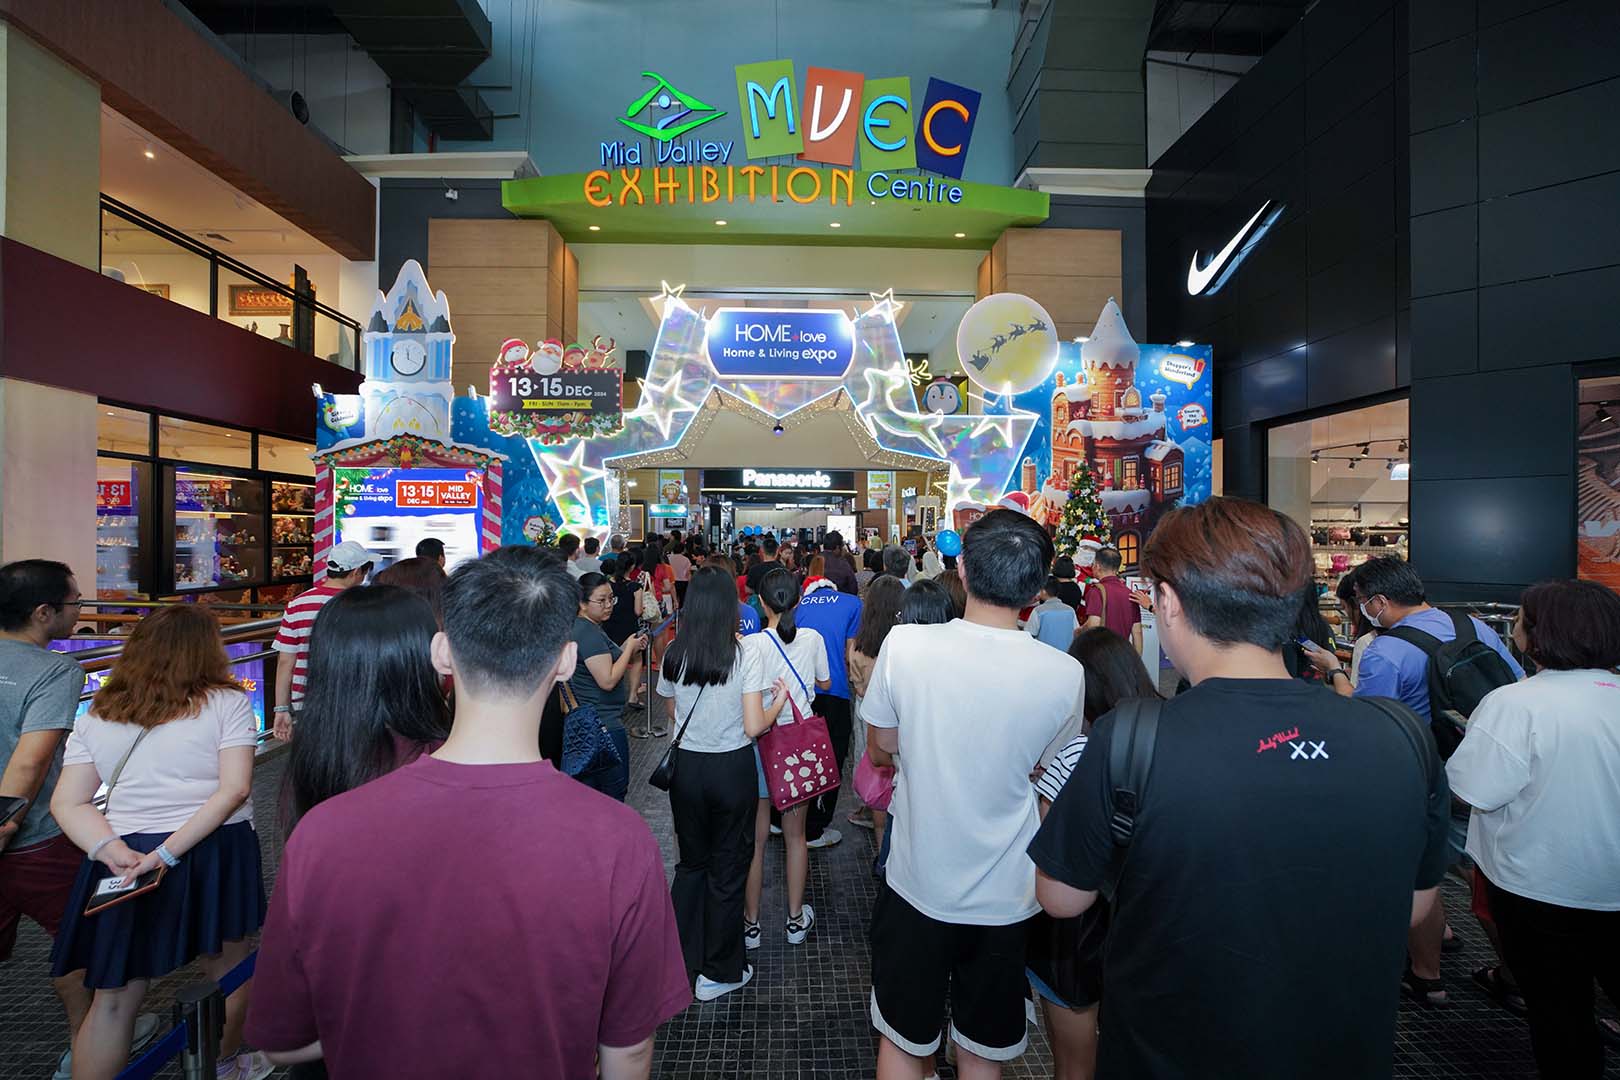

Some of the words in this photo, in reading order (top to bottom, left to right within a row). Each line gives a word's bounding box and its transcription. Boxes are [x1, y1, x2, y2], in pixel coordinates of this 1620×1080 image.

[746, 77, 969, 157] MVEC
[600, 141, 641, 166] Mid
[658, 139, 734, 164] Valley
[584, 165, 854, 207] EXHIBITION
[867, 172, 962, 204] Centre
[735, 324, 792, 342] HOME
[800, 330, 827, 343] love
[723, 347, 756, 358] Home
[758, 348, 766, 358] &
[769, 347, 800, 361] Living
[801, 347, 837, 365] expo
[565, 385, 593, 396] DEC
[350, 483, 374, 493] HOME
[742, 469, 832, 488] Panasonic
[800, 595, 839, 605] CREW
[1288, 740, 1329, 759] XX
